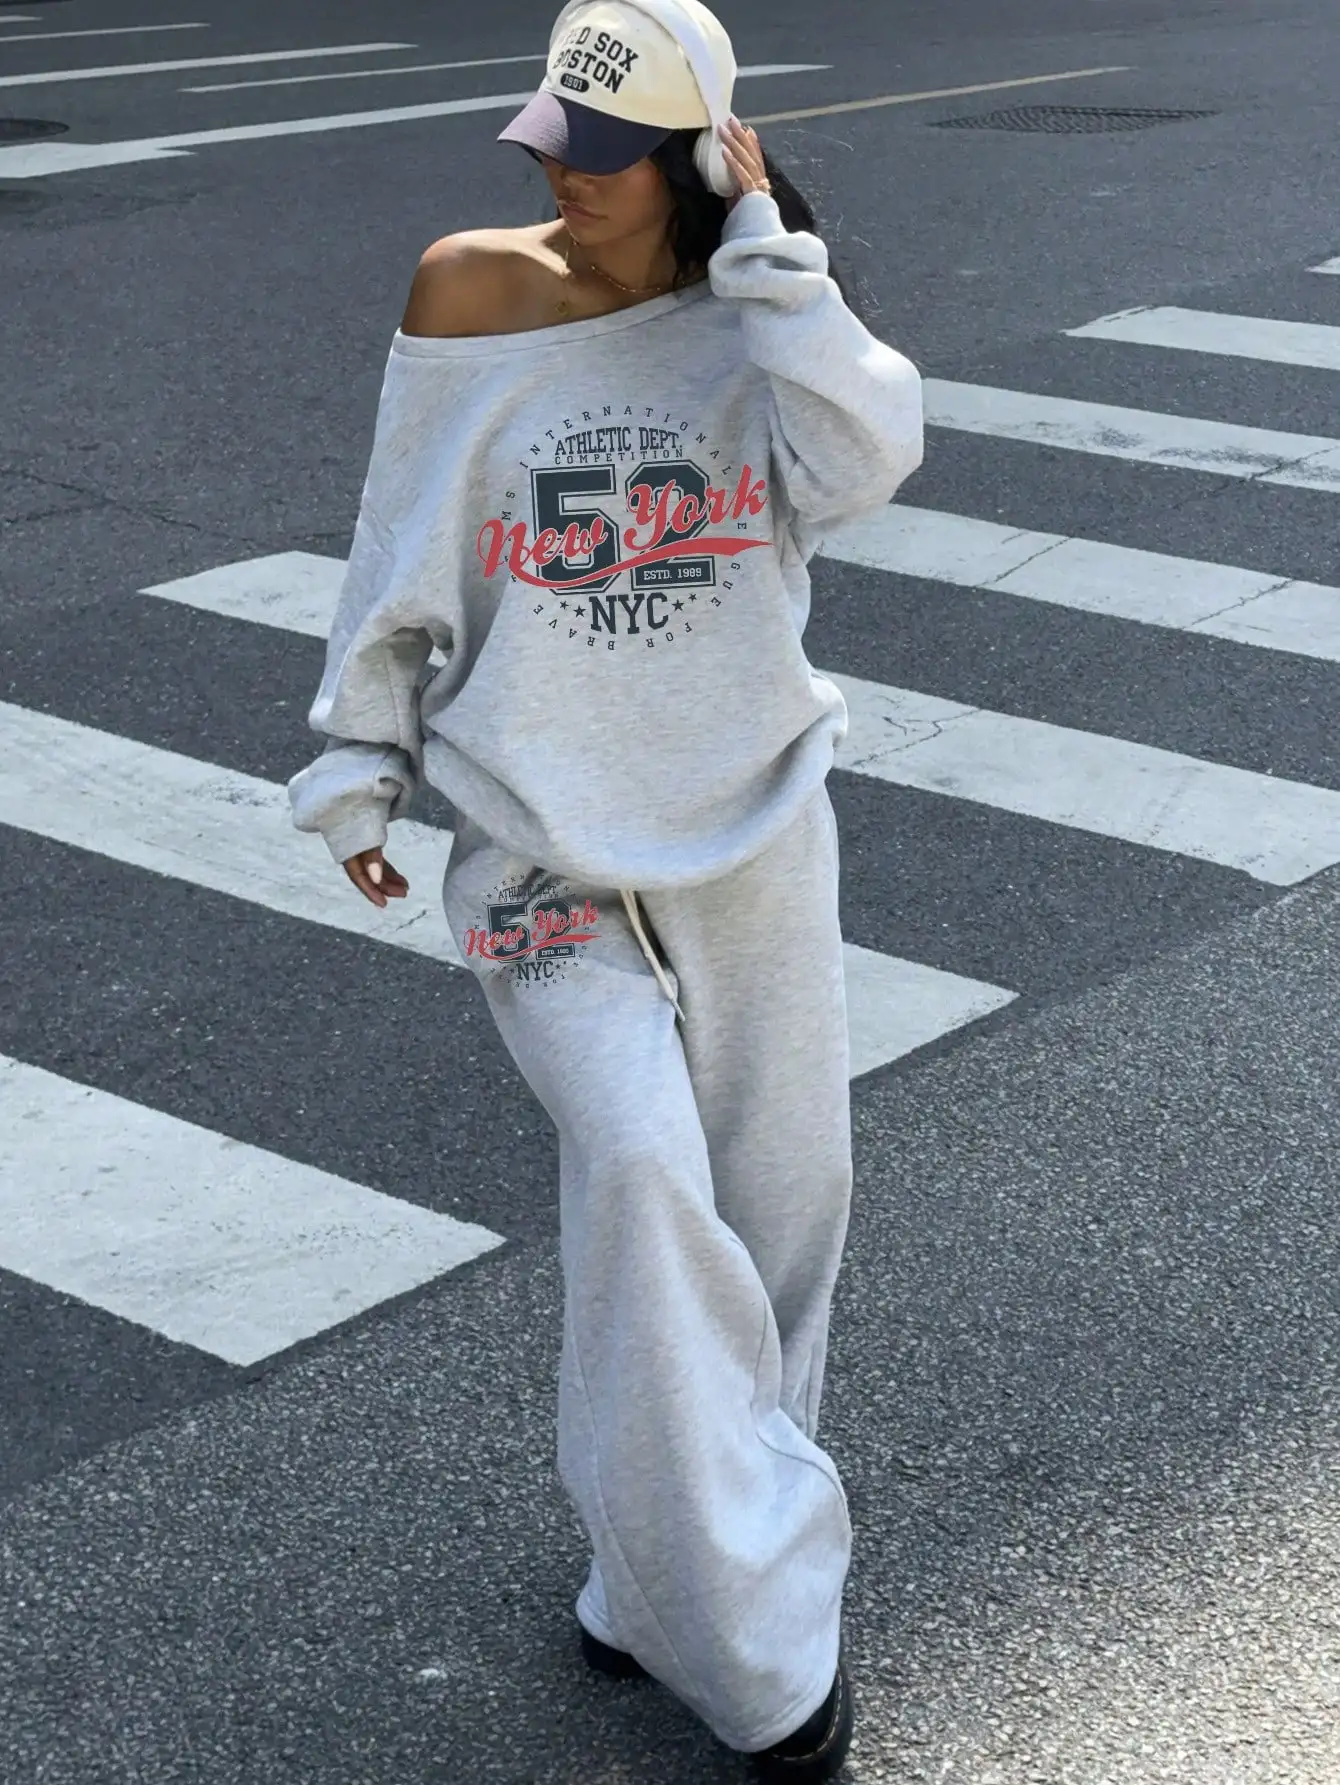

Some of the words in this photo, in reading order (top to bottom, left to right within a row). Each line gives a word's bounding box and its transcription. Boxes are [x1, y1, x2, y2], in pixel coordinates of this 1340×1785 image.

[552, 48, 625, 94] BOSTON
[594, 31, 639, 73] SOX
[563, 75, 584, 90] 1901
[519, 405, 731, 475] INTERNATIONAL
[554, 448, 683, 465] COMPETITION
[555, 426, 632, 456] ATHLETIC
[638, 426, 683, 452] DEPT.
[476, 517, 608, 580] New
[623, 463, 768, 551] York
[643, 569, 672, 581] ESTD.
[677, 567, 702, 579] 1989
[533, 603, 615, 651] BRAVE
[588, 592, 669, 634] NYC
[646, 622, 692, 648] FOR
[463, 926, 525, 957] New
[531, 899, 600, 941] York
[516, 960, 554, 981] NYC
